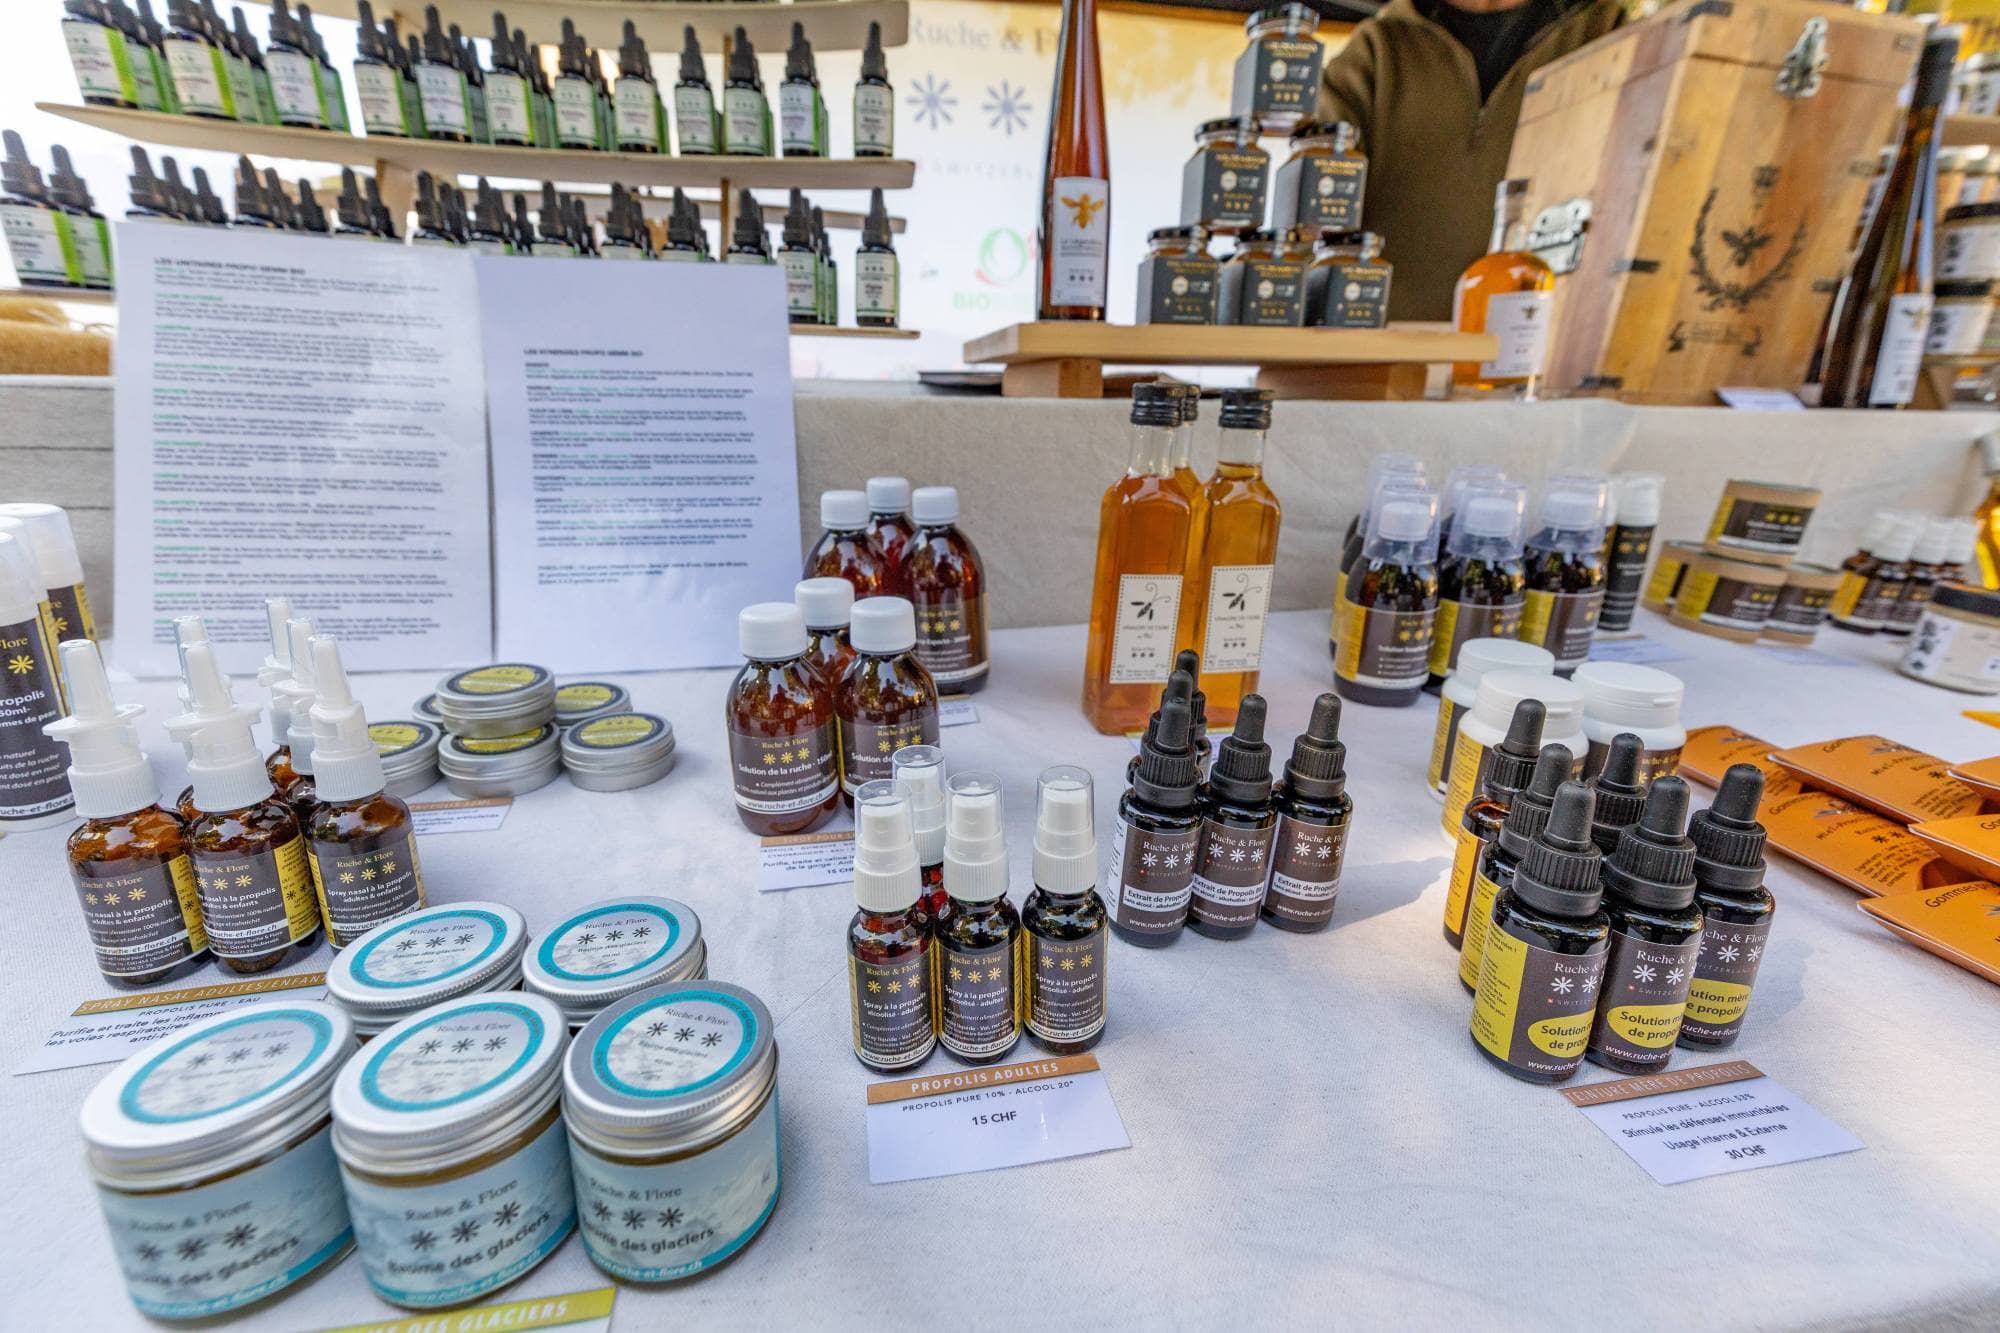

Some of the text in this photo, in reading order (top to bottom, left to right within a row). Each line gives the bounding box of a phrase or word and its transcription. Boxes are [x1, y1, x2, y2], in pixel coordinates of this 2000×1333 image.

[0, 689, 46, 707] ropolis
[761, 741, 783, 749] Ruche
[851, 752, 882, 763] Solution
[738, 763, 767, 776] Solution
[767, 768, 779, 776] de
[789, 763, 812, 774] ruche
[1210, 831, 1266, 847] Ruche & Flore
[1298, 831, 1324, 843] Ruche
[1143, 841, 1180, 852] Ruche &
[337, 859, 362, 869] Ruche
[374, 850, 394, 862] Flore
[216, 864, 250, 873] & Flore
[106, 877, 144, 888] & Flore
[327, 889, 347, 897] Spray
[348, 886, 370, 895] nasal
[377, 882, 385, 890] la
[386, 871, 412, 888] propolis
[1216, 886, 1227, 894] de
[1278, 876, 1302, 890] Extrait
[239, 887, 276, 902] propolis
[376, 885, 402, 897] enfants
[1128, 889, 1163, 903] Extrait de
[1925, 880, 1978, 908] Gommes
[123, 898, 174, 917] la propolis
[229, 900, 259, 910] enfants
[123, 913, 155, 924] enfants
[585, 917, 648, 929] Ruche Flore
[409, 926, 440, 936] Ruche
[1730, 933, 1768, 944] & Flore
[1041, 943, 1093, 953] Ruche Flore
[949, 953, 1001, 965] Ruche Flore
[1636, 949, 1675, 965] Ruche
[866, 967, 890, 976] Ruche
[901, 962, 920, 974] Flore
[1554, 961, 1590, 974] Ruche
[1036, 972, 1055, 986] Spray
[1062, 979, 1070, 987] la
[1071, 972, 1098, 987] propolis
[945, 984, 962, 998] Spray
[970, 991, 977, 999] la
[978, 985, 1008, 1000] propolis
[1039, 983, 1094, 994] alcoolisé adultes
[80, 998, 138, 1013] SPRAY
[140, 989, 195, 1006] NASAL
[863, 991, 927, 1011] Spray à la propolis
[949, 997, 1004, 1007] alcoolisé adultes
[1727, 992, 1748, 1003] mère
[138, 997, 262, 1017] PROPOLIS PURE EAU
[867, 1002, 924, 1018] alcoolisé adultes
[1697, 1003, 1742, 1017] propolis
[665, 1007, 729, 1026] Ruche & Flore
[1619, 1010, 1671, 1026] Solution
[44, 1021, 191, 1048] les voies respiratoires
[52, 1028, 98, 1039] Purifie
[100, 1024, 113, 1034] et
[115, 1020, 151, 1032] traite
[153, 1017, 171, 1027] les
[437, 1023, 512, 1033] Ruche Flore
[1541, 1024, 1586, 1037] Solution
[1628, 1027, 1645, 1038] de
[1549, 1040, 1564, 1050] de
[911, 1062, 1060, 1094] PROPOLIS ADULTES
[1566, 1084, 1630, 1102] TEINTURE
[1667, 1074, 1686, 1088] DE
[1686, 1063, 1751, 1084] PROPOLIS
[902, 1084, 1056, 1112] PROPOLIS PURE 10% ALCOOL
[1622, 1097, 1736, 1120] PROPOLIS PURE ALCOOL
[971, 1111, 1018, 1126] 15 CHF
[1622, 1104, 1791, 1139] Stimule les défenses immunitaires
[1663, 1122, 1788, 1151] Usage interne & Externe
[1725, 1145, 1766, 1160] 30 CHF
[459, 1200, 473, 1211] &
[478, 1180, 518, 1205] Flore
[628, 1190, 641, 1200] &
[646, 1187, 682, 1201] Flore
[181, 1201, 250, 1228] & Flore
[387, 1211, 550, 1274] Baume des glaciers
[620, 1227, 714, 1254] des glaciers
[177, 1235, 299, 1286] des glaciers
[458, 1301, 569, 1331] GLACIERS
